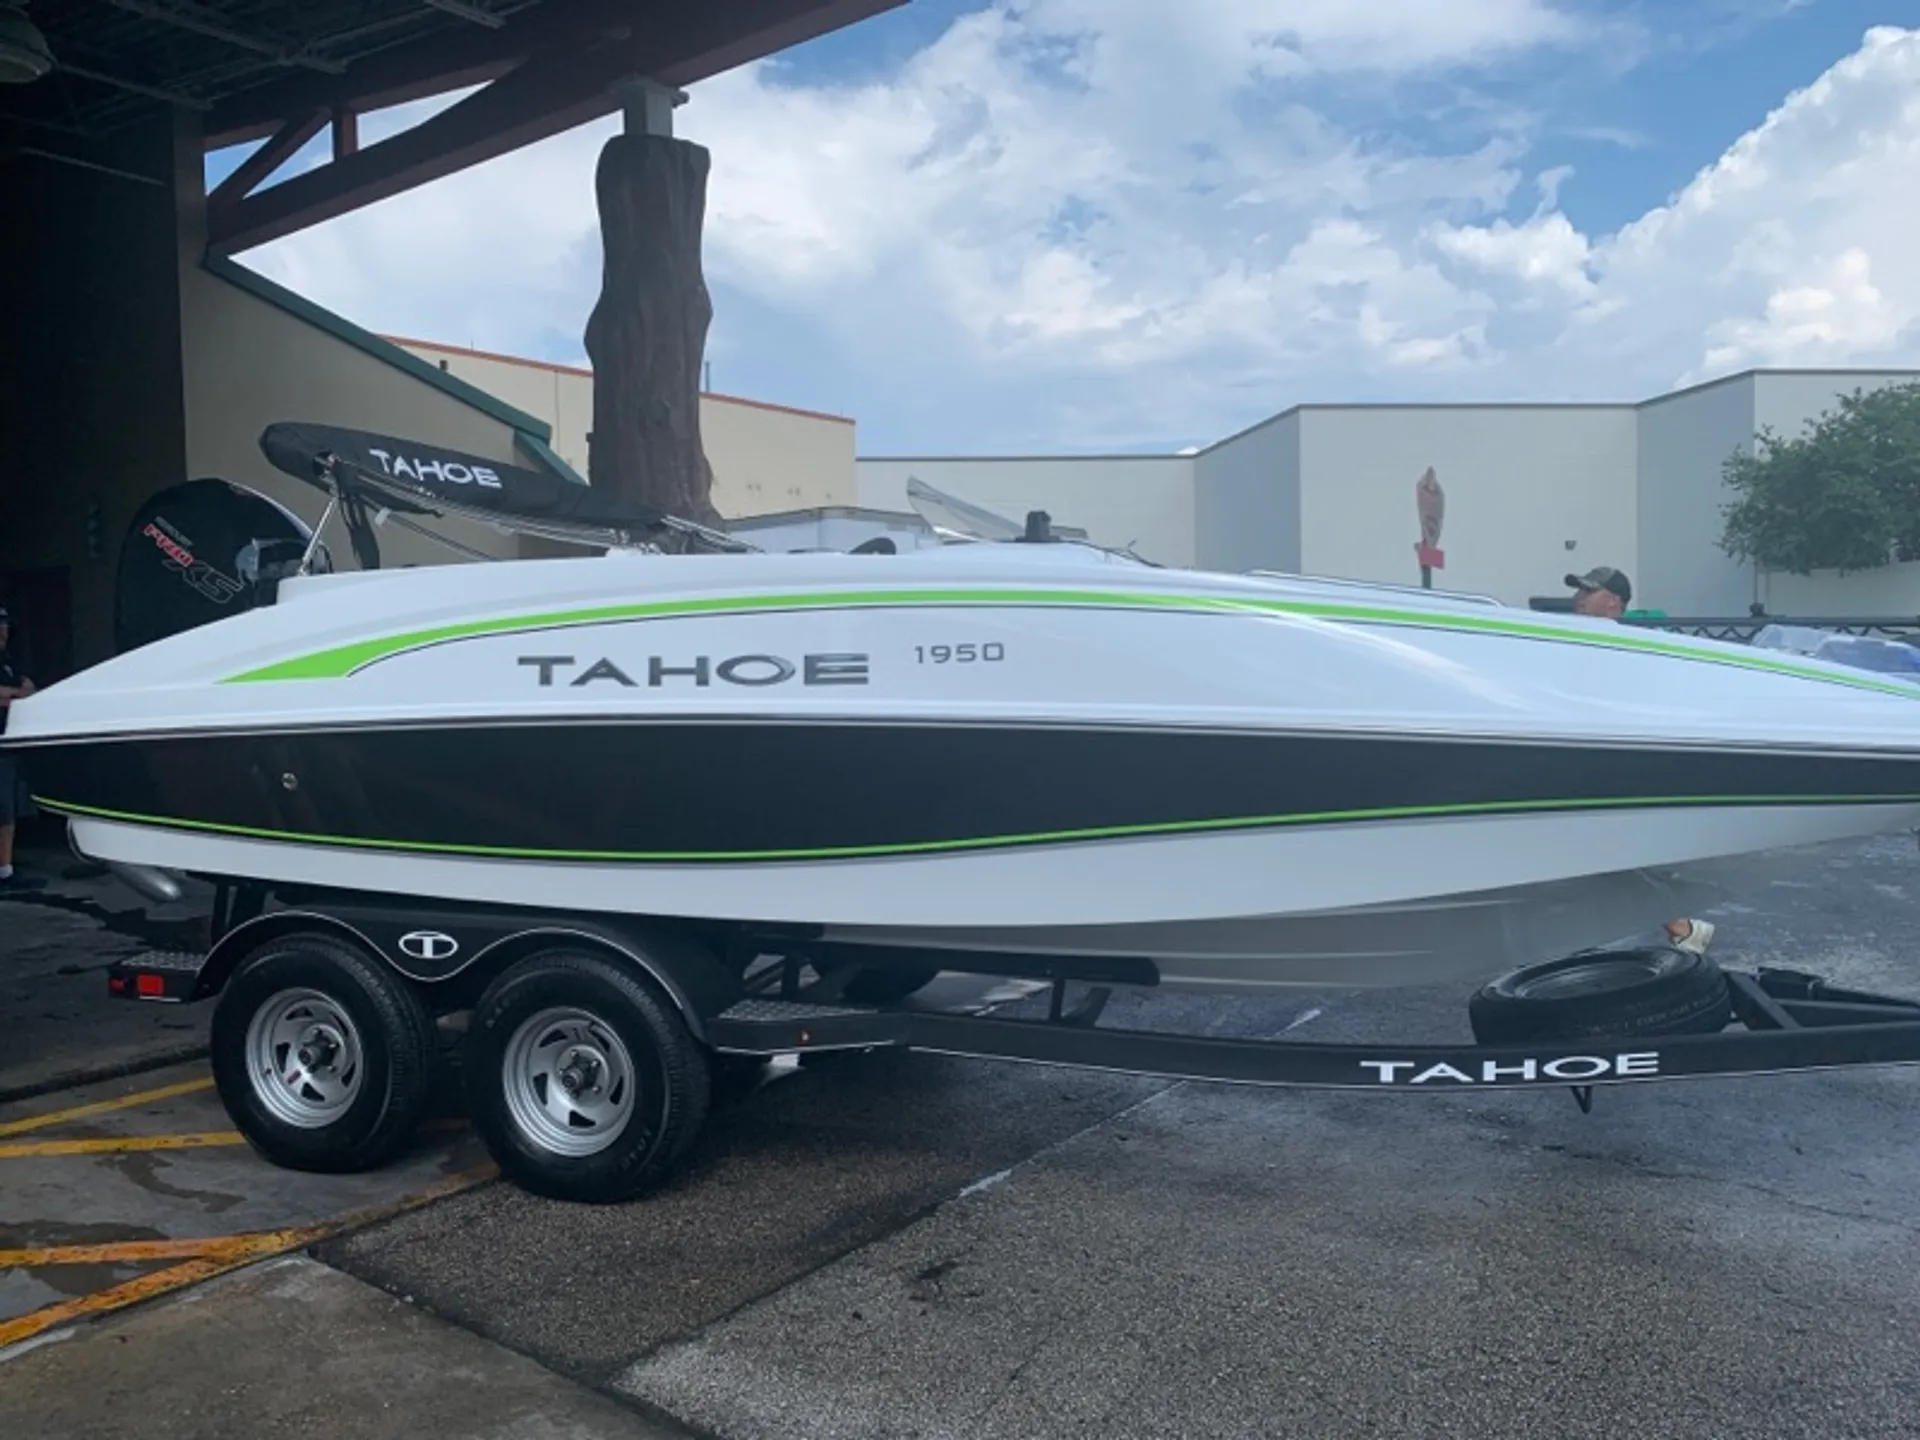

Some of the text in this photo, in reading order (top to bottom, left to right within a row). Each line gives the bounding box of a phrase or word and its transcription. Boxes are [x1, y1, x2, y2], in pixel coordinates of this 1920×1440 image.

[368, 448, 503, 489] TAHOE
[516, 642, 1006, 688] TAHOE 1950
[1359, 1051, 1660, 1084] TAHOE
